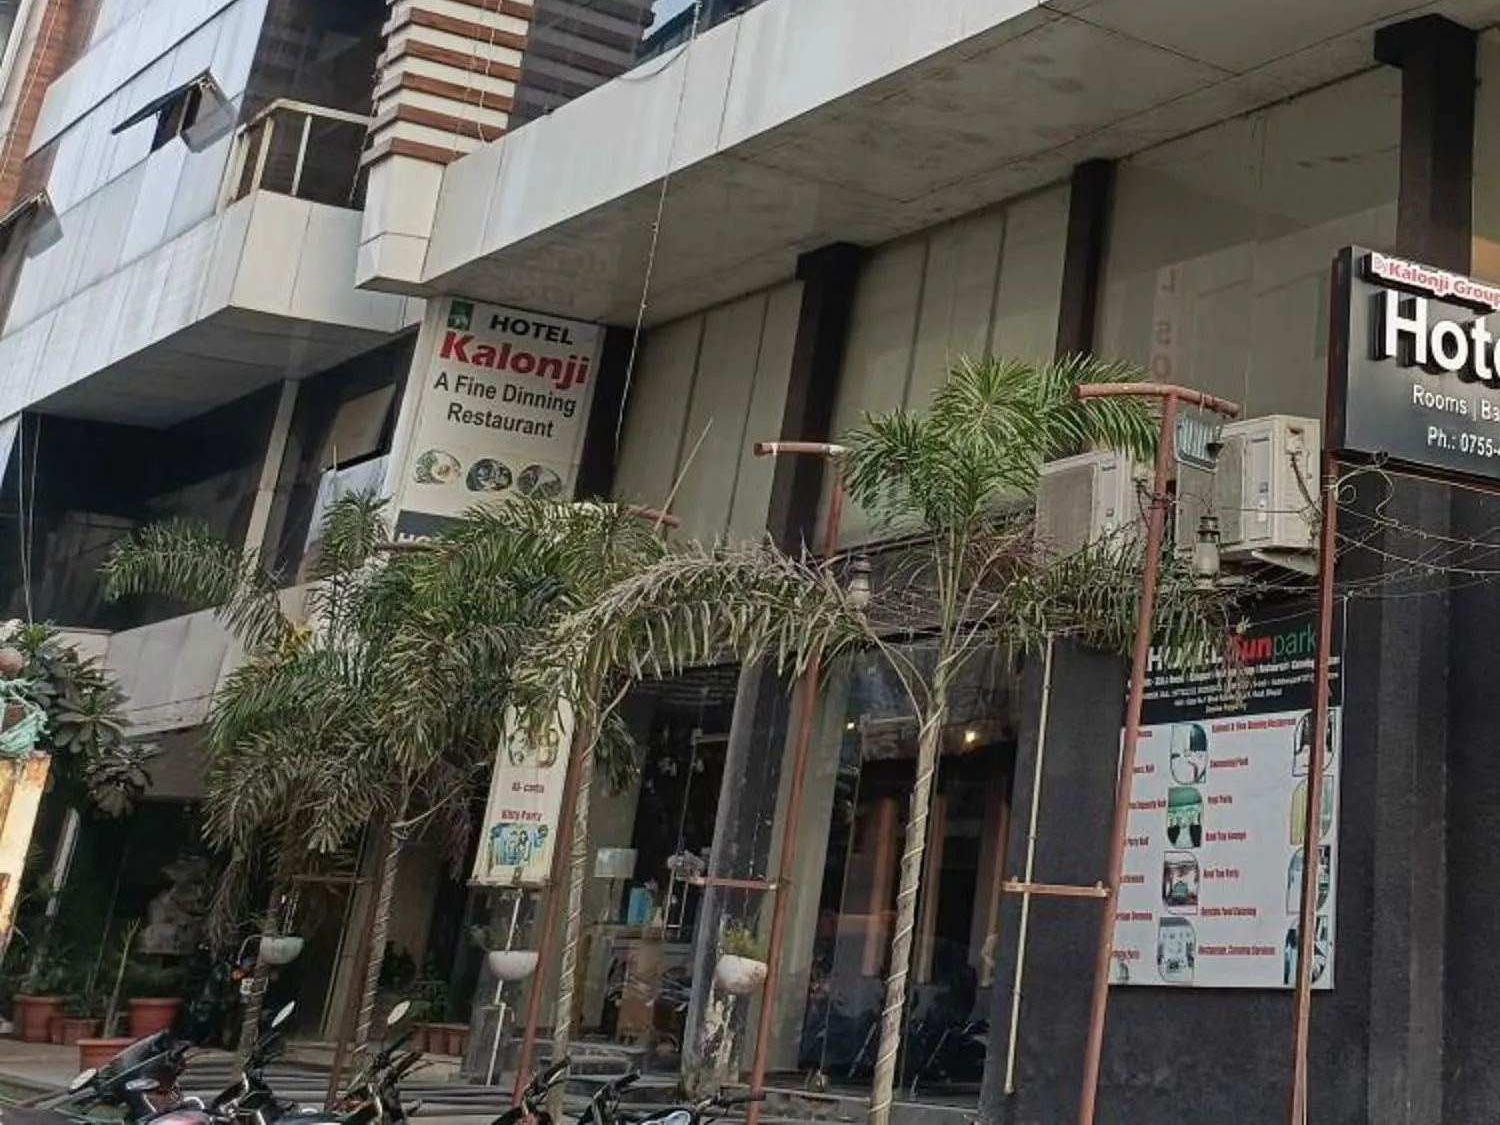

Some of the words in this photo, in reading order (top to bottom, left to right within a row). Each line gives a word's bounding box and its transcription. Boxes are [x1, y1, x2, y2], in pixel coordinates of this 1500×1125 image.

[1389, 262, 1449, 292] Kalonji
[490, 314, 573, 345] HOTEL
[439, 330, 590, 391] Kalonji
[434, 372, 448, 391] A
[454, 374, 497, 400] Fine
[503, 384, 577, 417] Dinning
[1413, 384, 1467, 415] Rooms
[447, 402, 554, 438] Restaurant
